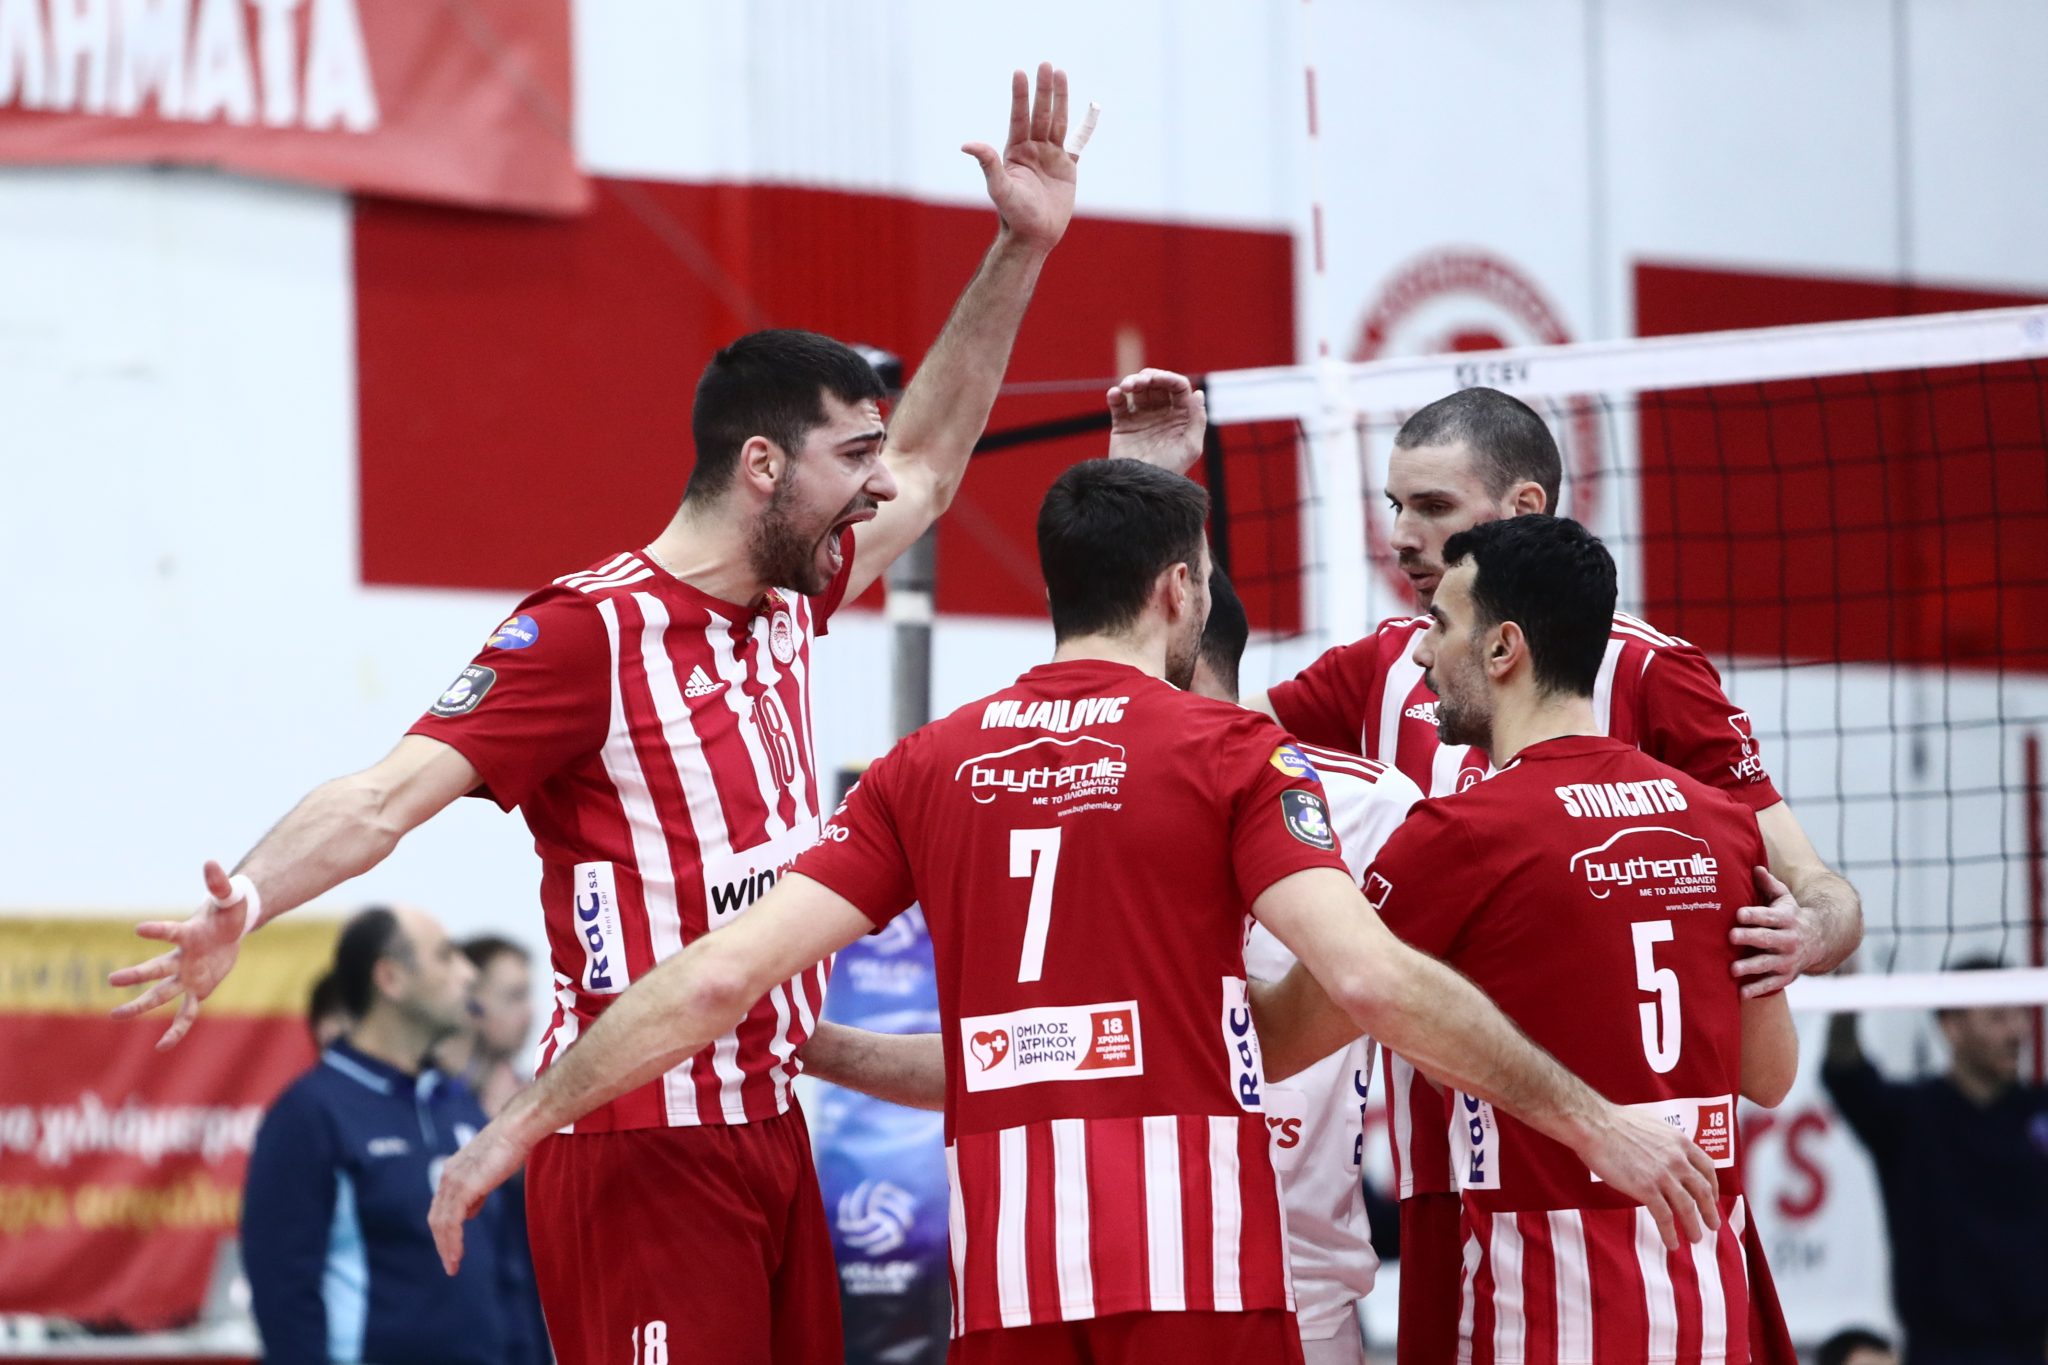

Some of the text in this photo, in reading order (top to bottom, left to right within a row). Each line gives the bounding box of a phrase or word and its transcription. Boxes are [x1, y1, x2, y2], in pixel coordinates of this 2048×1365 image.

[981, 696, 1130, 733] MIJAILOVIC
[1405, 707, 1440, 727] adida
[749, 695, 795, 793] 18
[971, 757, 1127, 793] buythemile
[1069, 777, 1119, 791] ΑΣΦΑΛΙΣΗ
[1298, 795, 1320, 807] CEV
[1554, 778, 1688, 818] STIVACHTIS
[1057, 802, 1123, 818] www.buythemile.gr
[1584, 853, 1718, 886] buythemile
[1674, 876, 1715, 885] ΑΣΦΑΛΙΣΗ
[1009, 826, 1062, 984] 7
[1665, 902, 1722, 911] www.buythemile.gr
[577, 892, 612, 989] RaC
[1630, 919, 1682, 1074] 5
[1016, 1023, 1068, 1038] ΟΜΙΛΟΣ
[1102, 1018, 1123, 1034] 18
[1018, 1036, 1076, 1052] ΙΑΤΡΙΚΟΥ
[1097, 1034, 1130, 1045] ΧΡΟΝΙΑ
[1019, 1050, 1076, 1066] ΑΘΗΝΩΝ
[1230, 1008, 1260, 1105] RaC
[1708, 1112, 1724, 1127] 18
